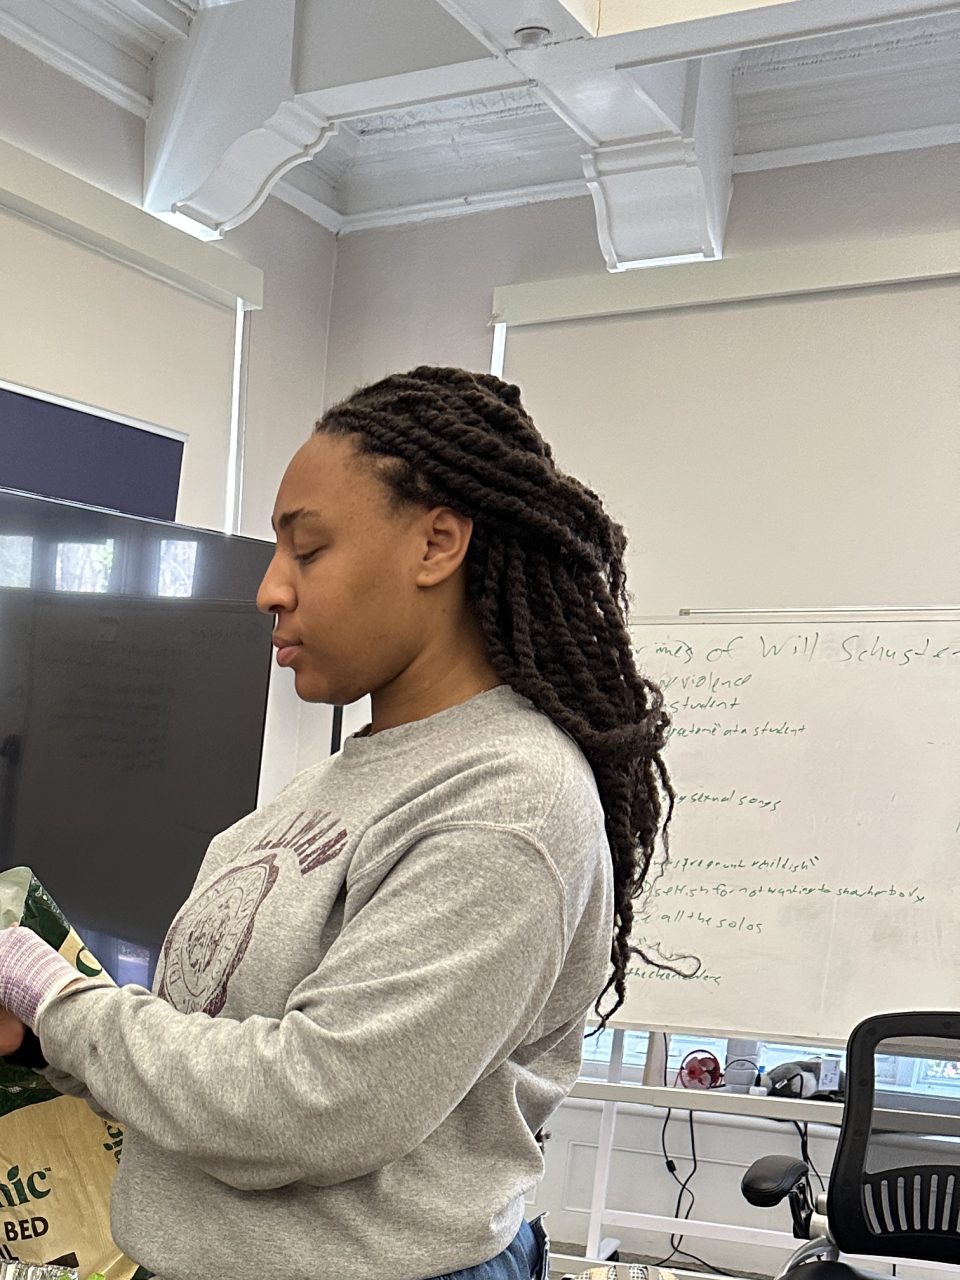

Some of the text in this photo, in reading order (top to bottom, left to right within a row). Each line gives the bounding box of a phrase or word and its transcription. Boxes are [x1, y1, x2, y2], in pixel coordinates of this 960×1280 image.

[706, 635, 743, 663] of
[760, 632, 819, 663] Will
[681, 671, 753, 693] violence
[669, 696, 742, 714] student
[752, 721, 808, 737] student
[660, 909, 686, 924] all
[687, 911, 713, 926] the
[716, 916, 764, 935] solos
[3, 1216, 50, 1242] BED
